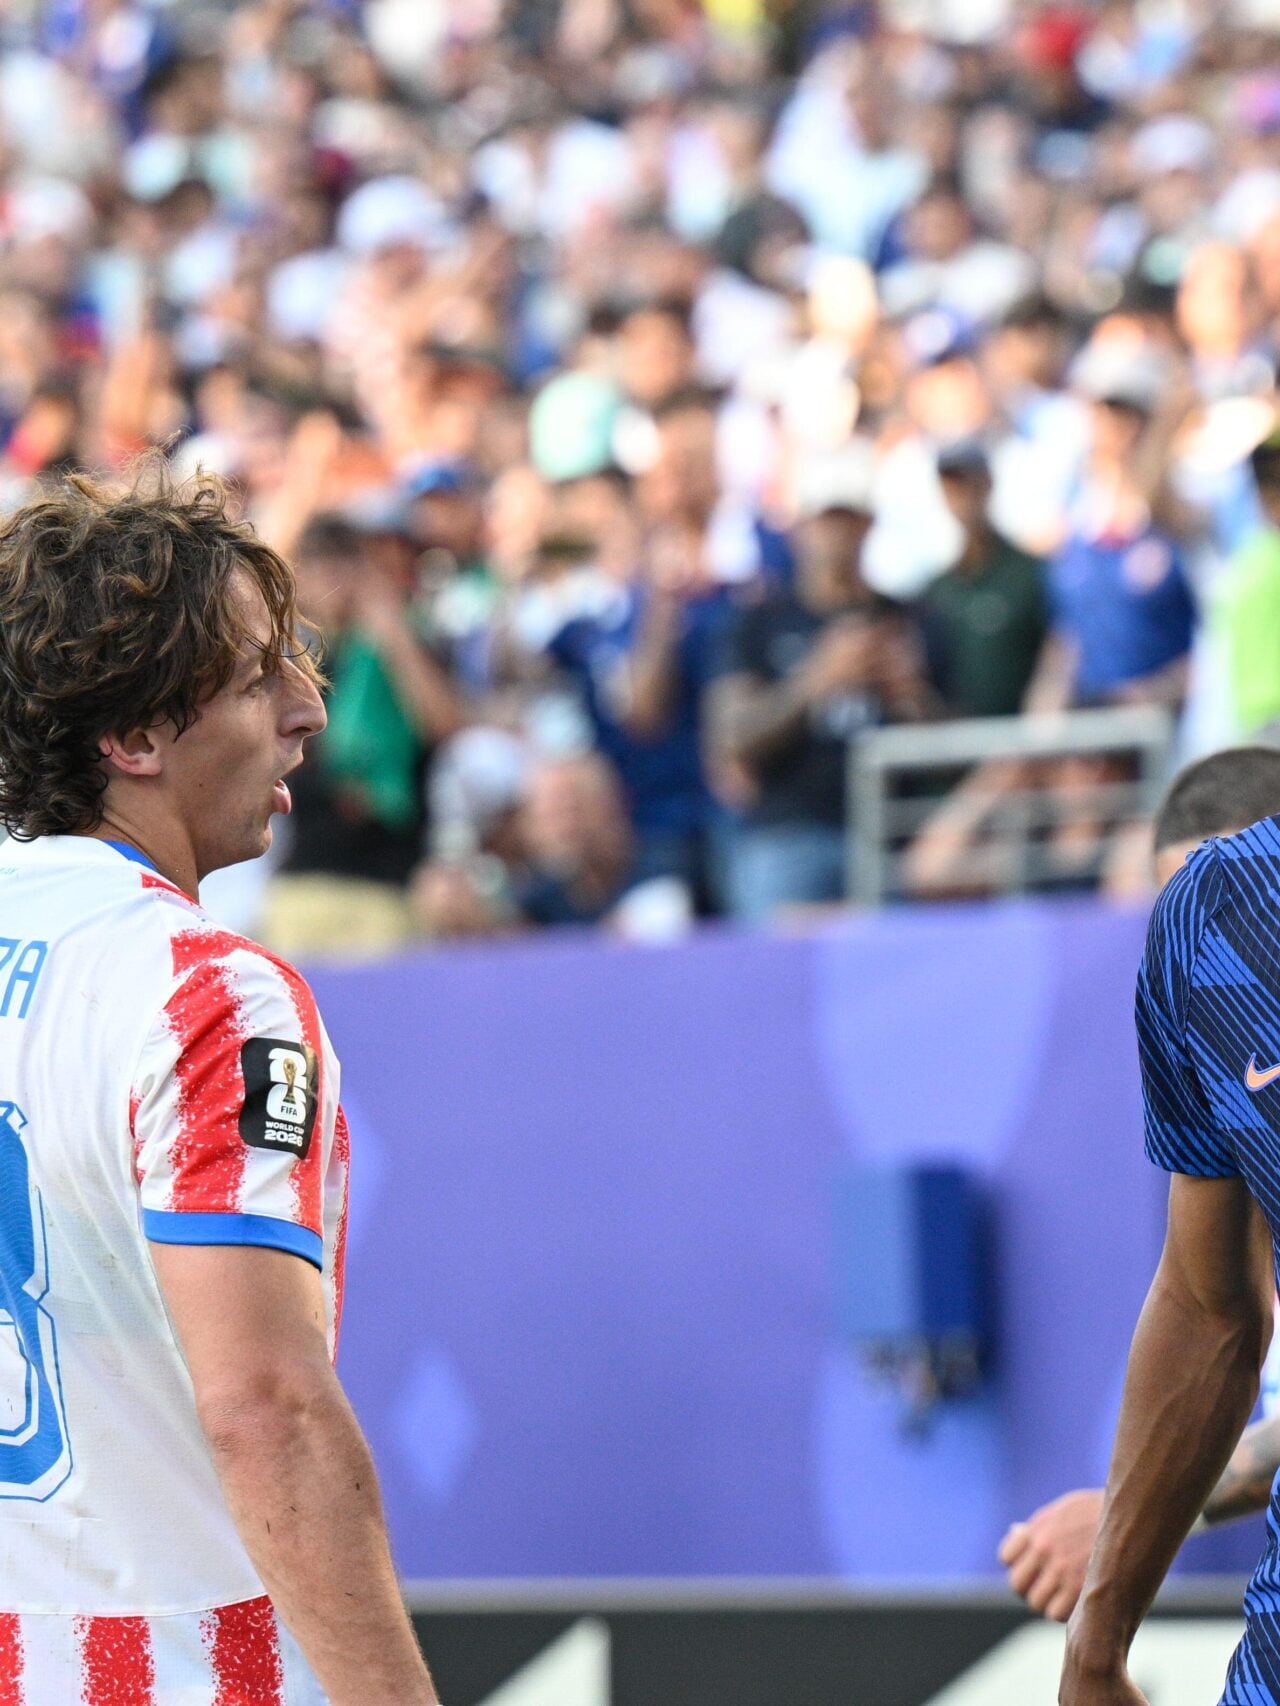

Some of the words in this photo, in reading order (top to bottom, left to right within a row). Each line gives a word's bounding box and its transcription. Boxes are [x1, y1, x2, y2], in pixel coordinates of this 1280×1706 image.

[281, 1105, 297, 1116] FIFA
[265, 1120, 293, 1132] WORLD
[264, 1129, 303, 1147] 2026
